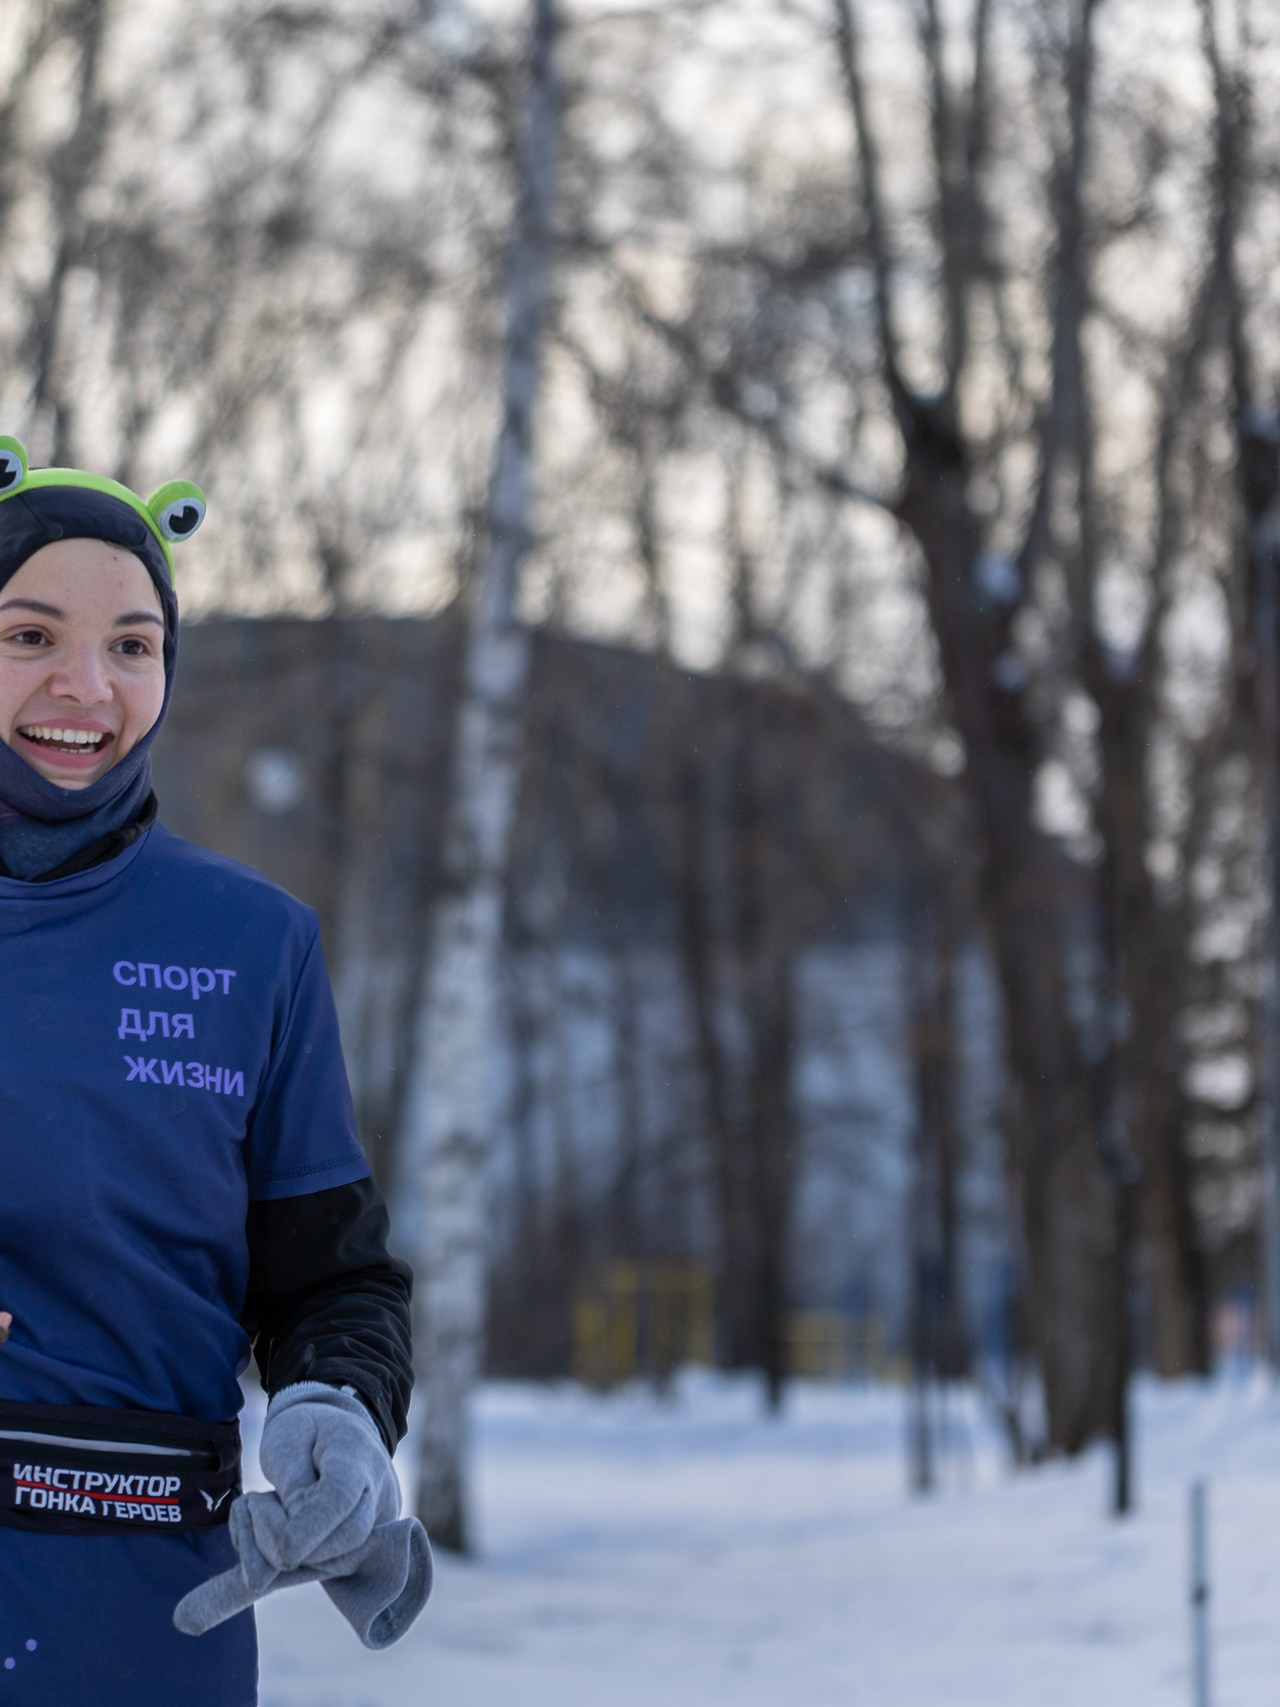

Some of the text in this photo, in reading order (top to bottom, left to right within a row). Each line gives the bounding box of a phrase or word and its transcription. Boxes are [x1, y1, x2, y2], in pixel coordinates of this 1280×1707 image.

[113, 960, 237, 1000] спорт
[118, 1007, 195, 1042] для
[123, 1055, 245, 1097] жизни
[13, 1463, 181, 1497] ИНСТРУКТОР
[15, 1486, 182, 1523] ГОНКА ГЕРОЕВ
